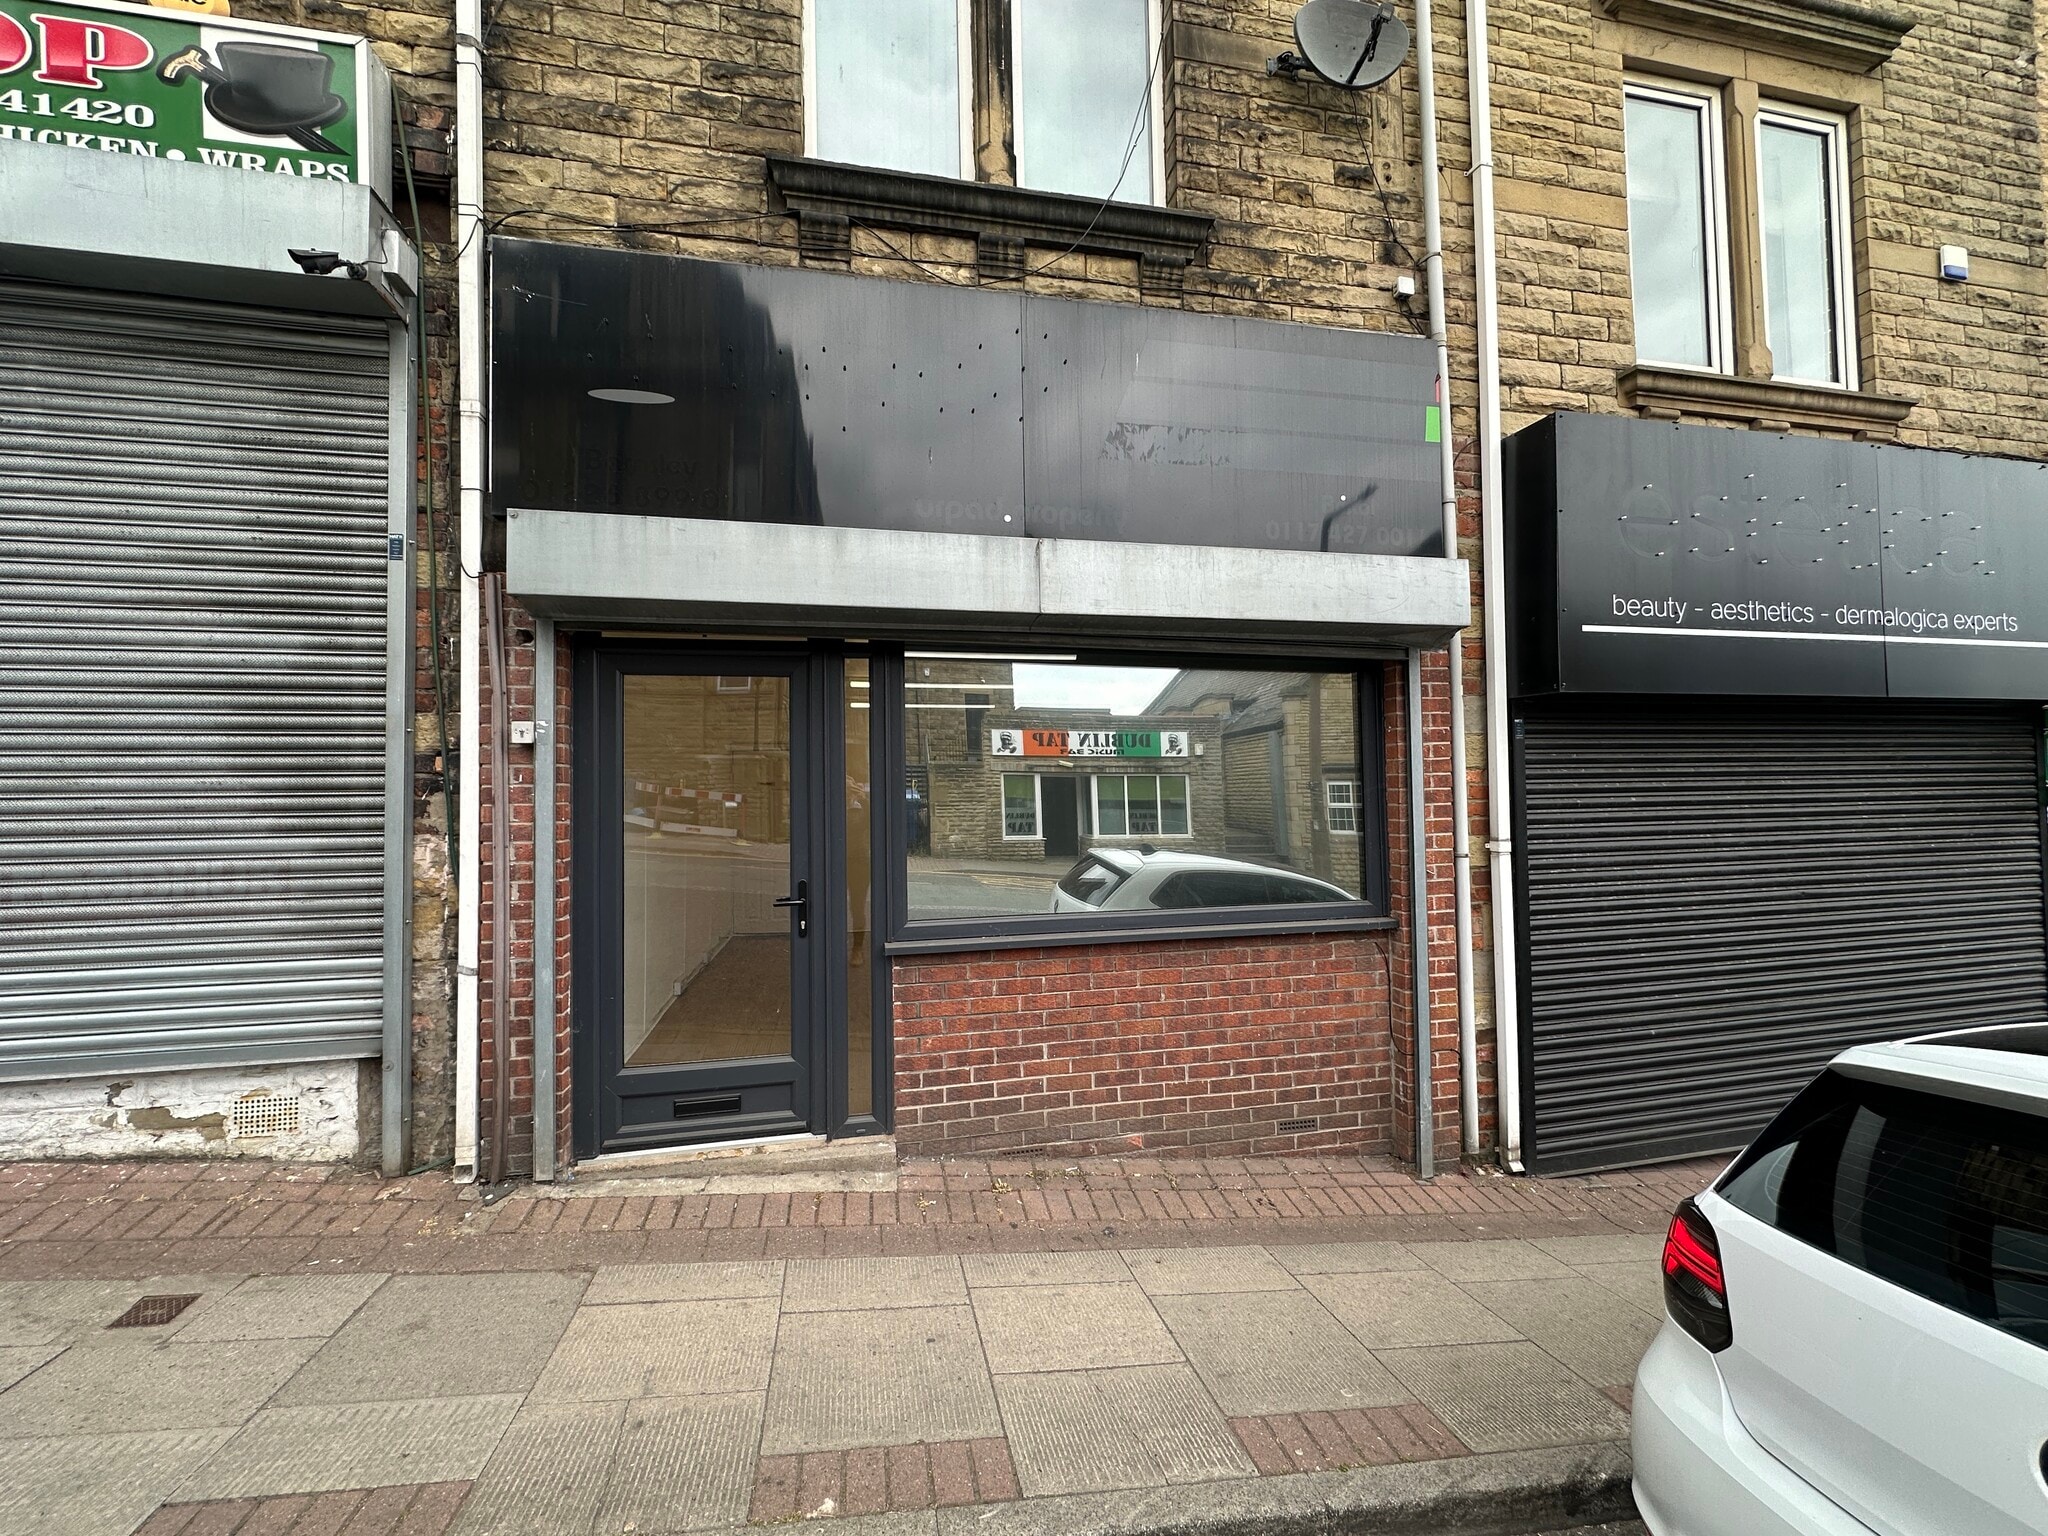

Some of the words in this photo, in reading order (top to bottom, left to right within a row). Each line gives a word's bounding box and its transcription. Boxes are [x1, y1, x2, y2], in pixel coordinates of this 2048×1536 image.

[0, 89, 155, 128] 41420
[197, 147, 350, 183] WRAPS
[1612, 594, 1688, 624] beauty
[1710, 600, 1815, 623] aesthetics
[1835, 604, 1949, 633] dermalogica
[1953, 612, 2018, 635] experts
